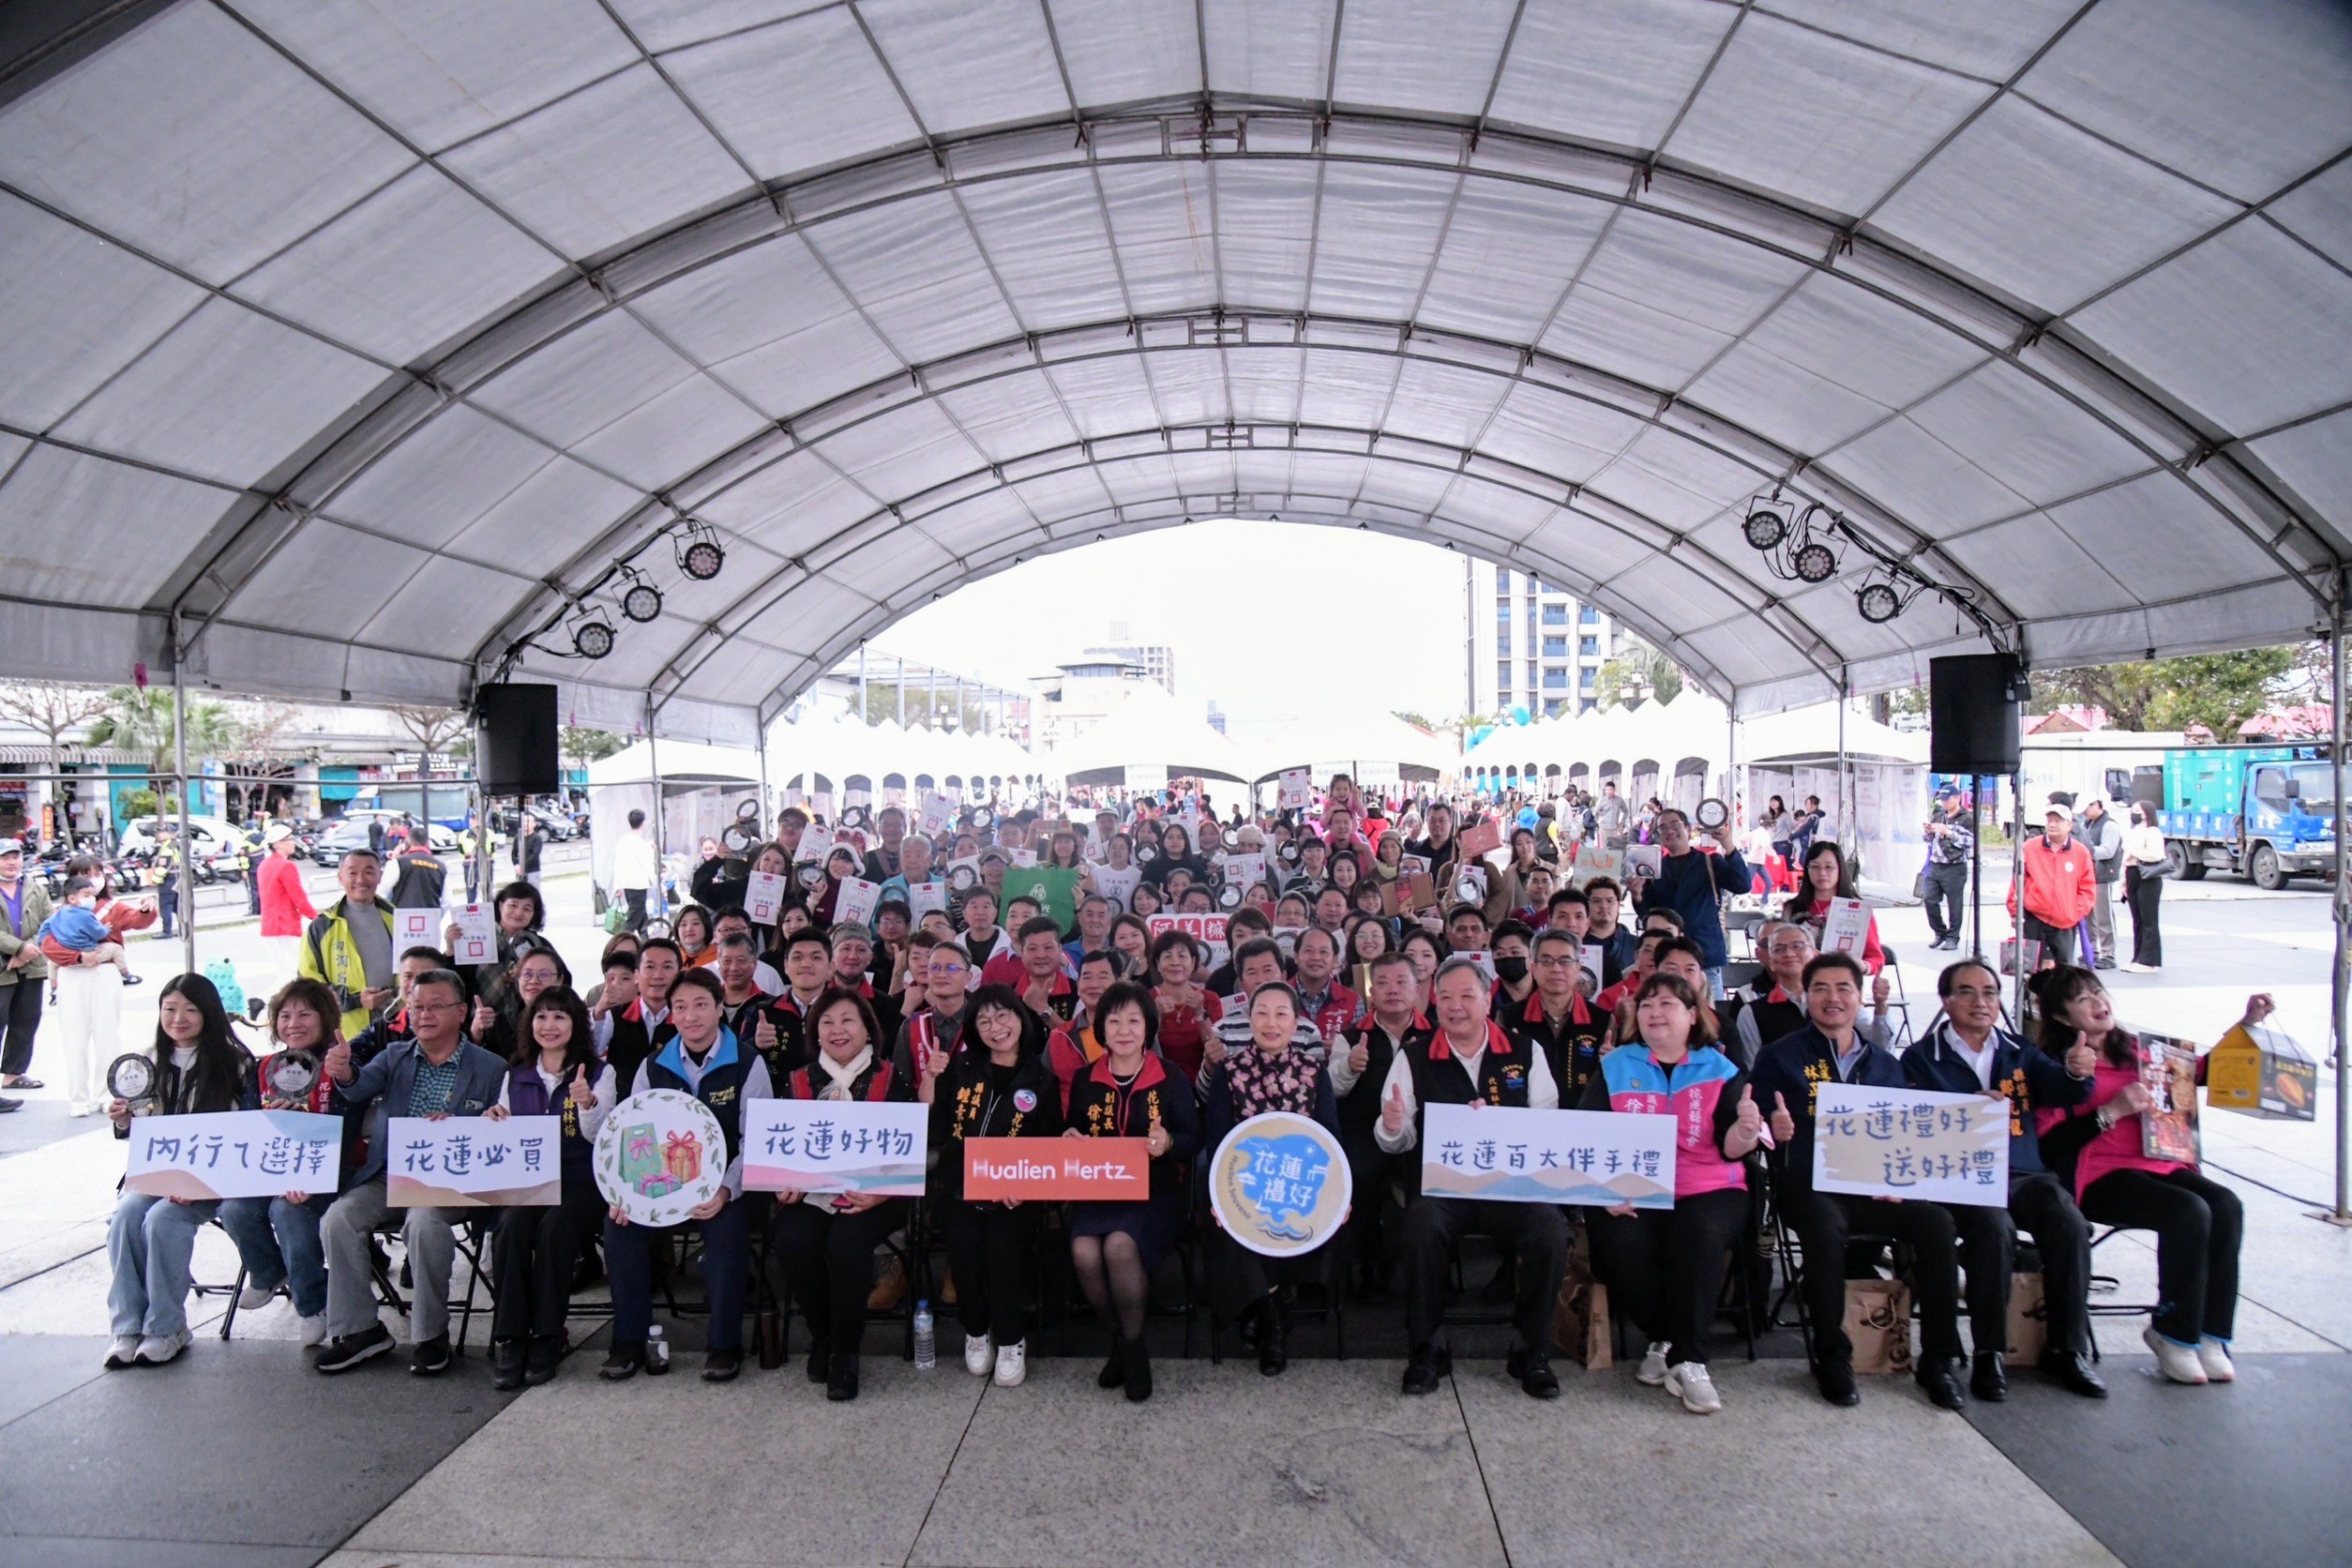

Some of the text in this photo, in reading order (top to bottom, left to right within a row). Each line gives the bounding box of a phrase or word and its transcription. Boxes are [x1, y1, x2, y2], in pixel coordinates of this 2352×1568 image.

[765, 1120, 913, 1160] 花蓮好物
[1826, 1101, 1972, 1140] 花蓮禮好
[405, 1135, 543, 1176] 花蓮必買
[972, 1158, 1139, 1181] Hualien Hertz
[1255, 1149, 1304, 1181] 花蓮
[1440, 1139, 1661, 1177] 花蓮百大伴手禮
[1883, 1146, 1996, 1187] 送好禮
[1228, 1154, 1252, 1220] Hualien Souvenir
[1263, 1177, 1313, 1208] 禮好
